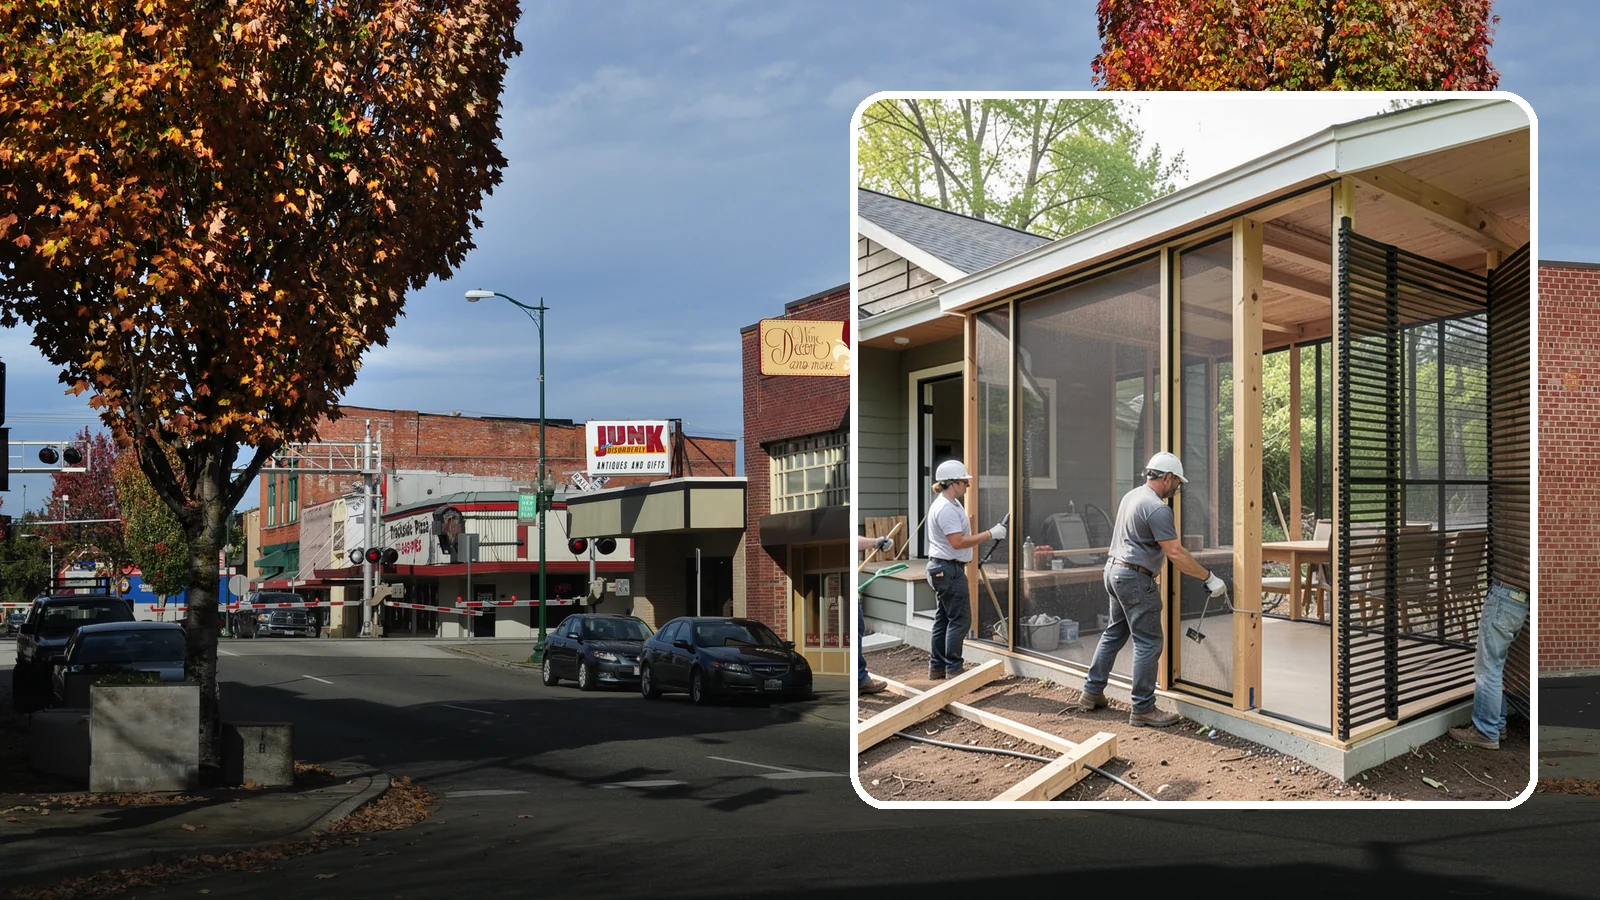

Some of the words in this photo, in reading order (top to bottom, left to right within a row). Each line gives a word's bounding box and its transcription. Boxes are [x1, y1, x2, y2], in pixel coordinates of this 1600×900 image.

[765, 327, 831, 365] Decor
[595, 425, 665, 457] JUNK
[607, 446, 646, 454] DISORDERLY
[596, 461, 628, 470] ANTIQUES
[631, 461, 644, 470] AND
[647, 460, 665, 470] GIFTS
[414, 519, 429, 535] Pizza
